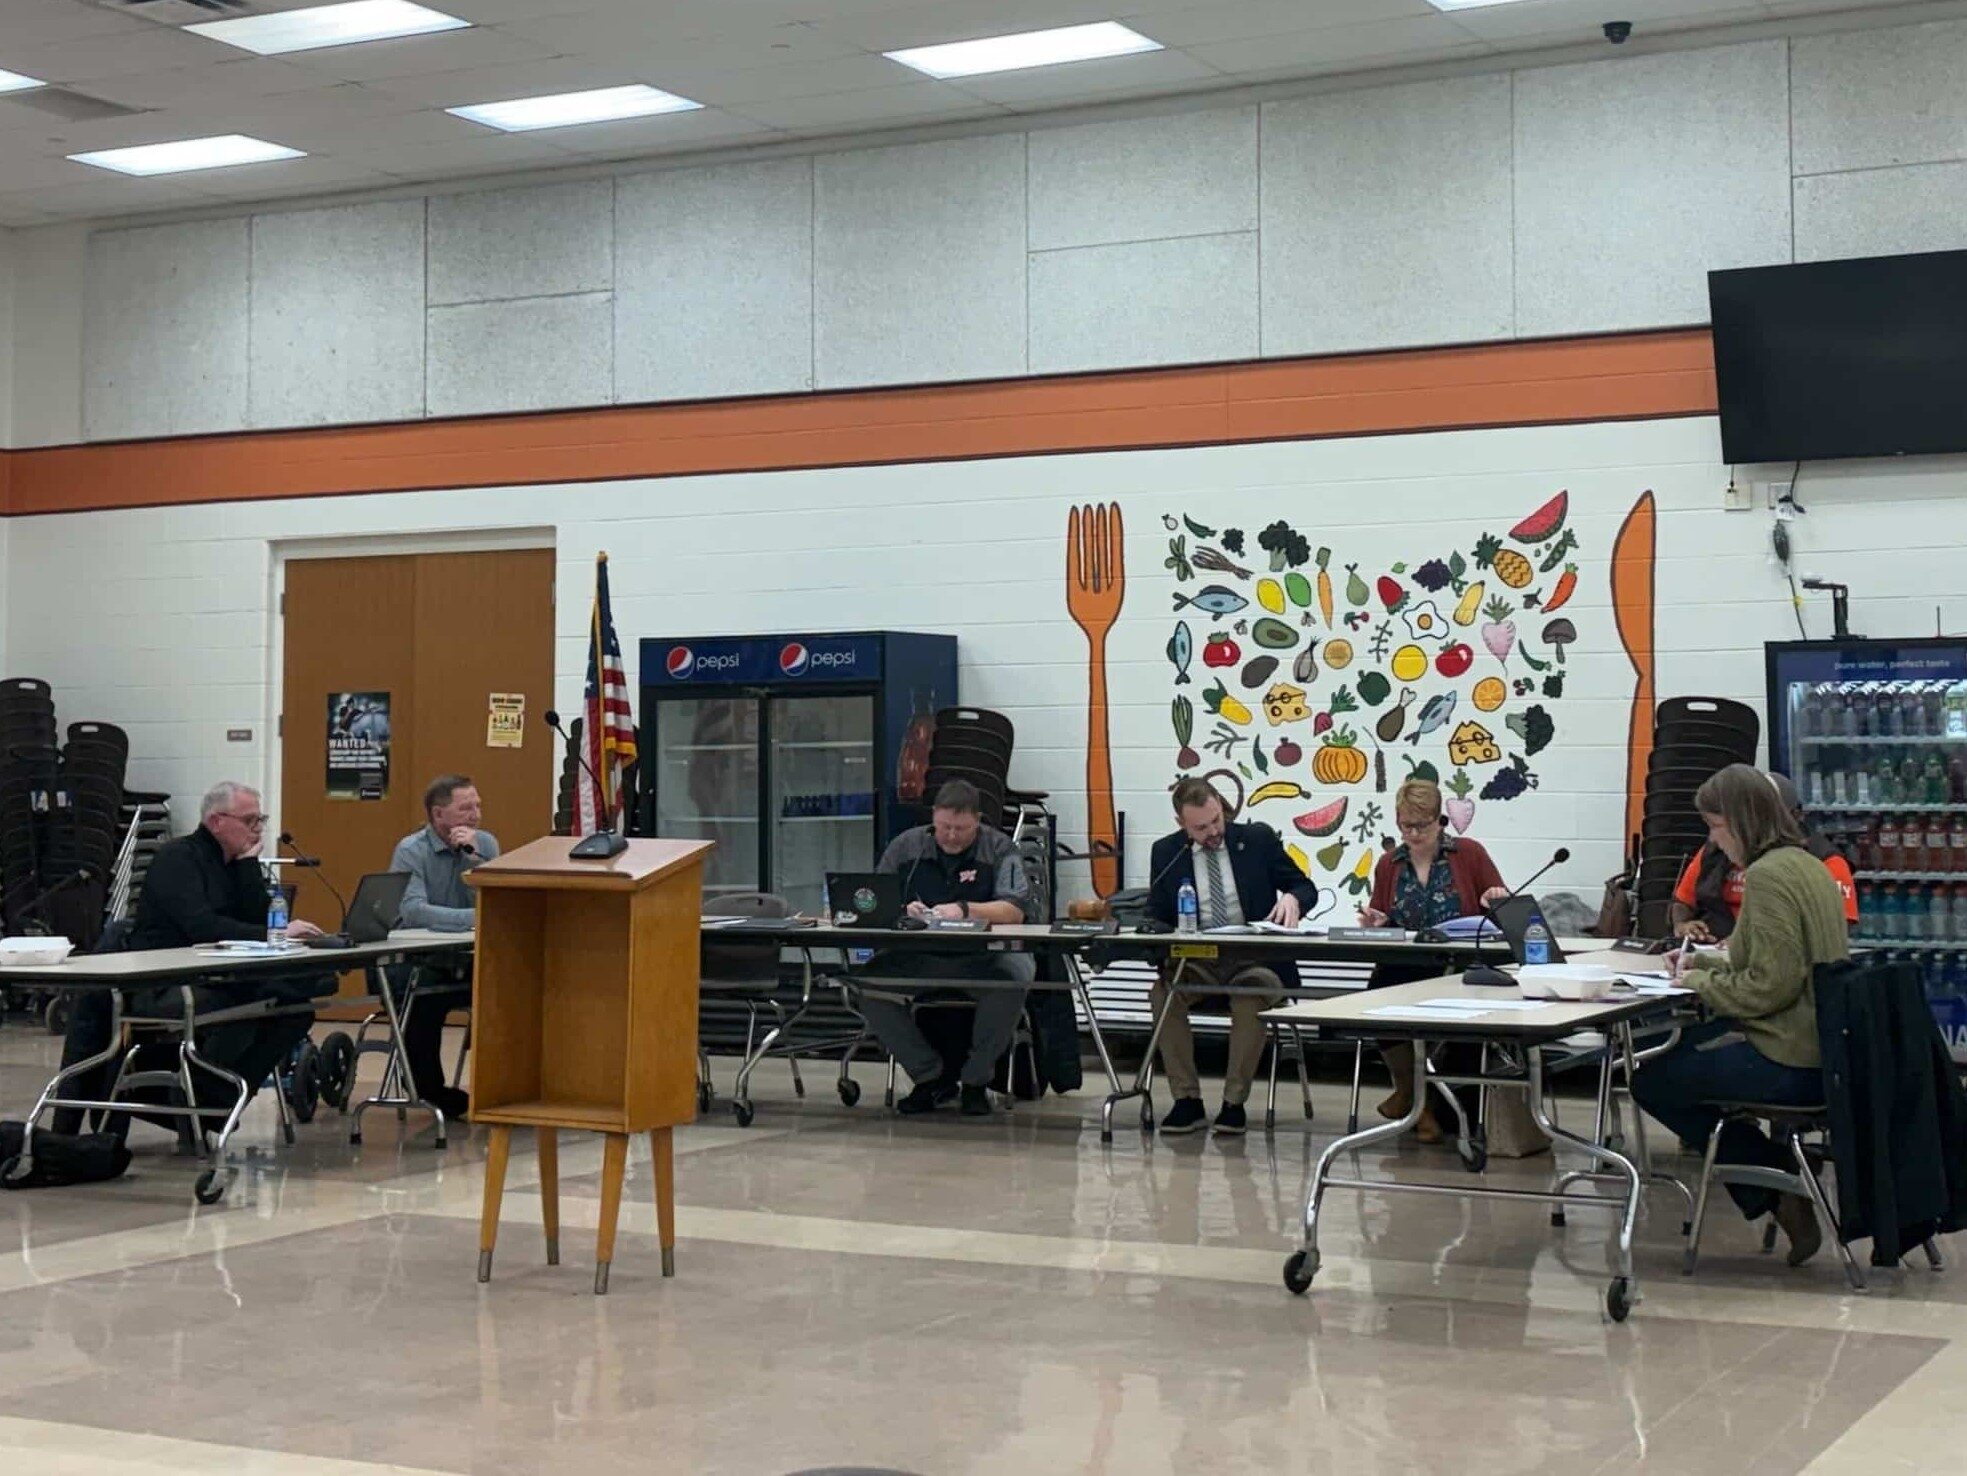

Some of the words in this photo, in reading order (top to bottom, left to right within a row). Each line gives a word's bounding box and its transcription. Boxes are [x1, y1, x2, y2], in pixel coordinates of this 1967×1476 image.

[697, 653, 740, 671] pepsi
[811, 649, 855, 668] pepsi
[329, 739, 366, 749] WANTED
